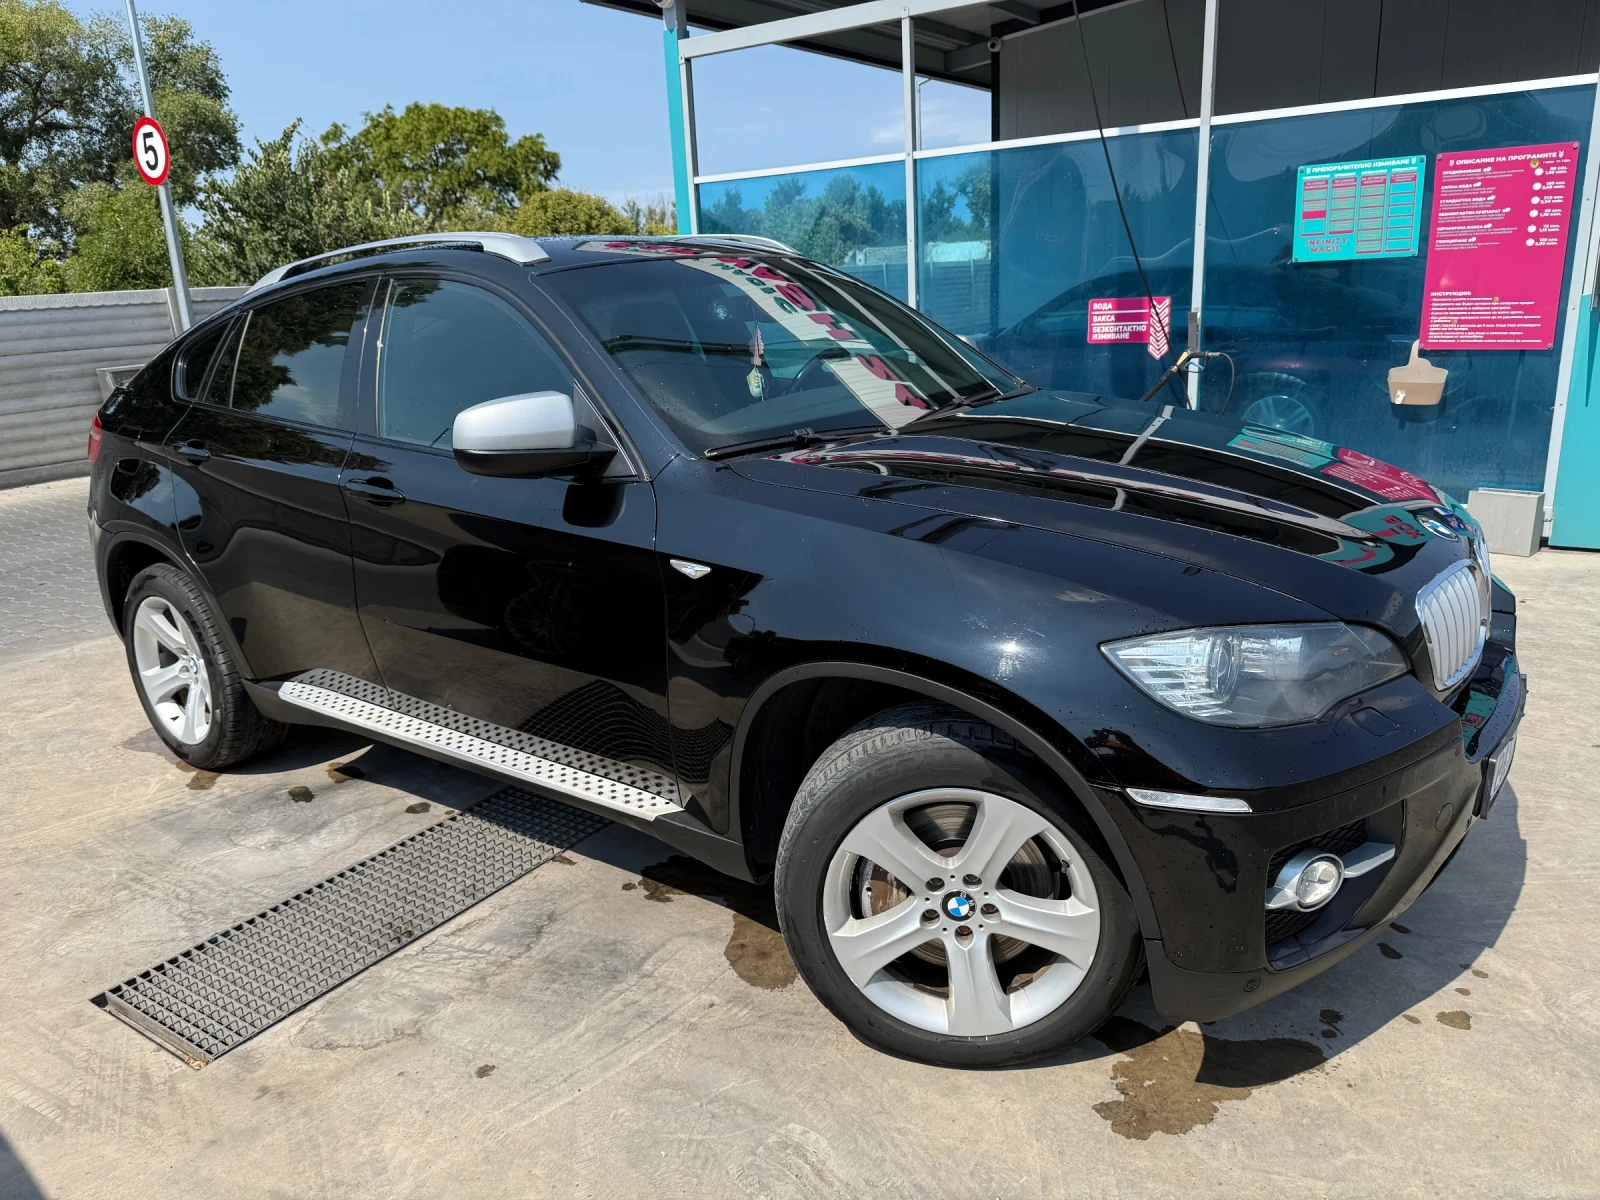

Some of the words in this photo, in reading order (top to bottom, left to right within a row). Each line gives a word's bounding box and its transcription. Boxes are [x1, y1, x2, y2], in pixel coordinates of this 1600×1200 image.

[142, 131, 158, 171] 5
[1508, 152, 1557, 160] ПРОГРАМИТЕ
[1312, 162, 1372, 173] ПРЕПОРЪЧИТЕЛНО
[1373, 159, 1410, 167] ИЗМИВАНЕ
[1306, 238, 1348, 246] INFINITY
[1093, 302, 1112, 310] ВОДА
